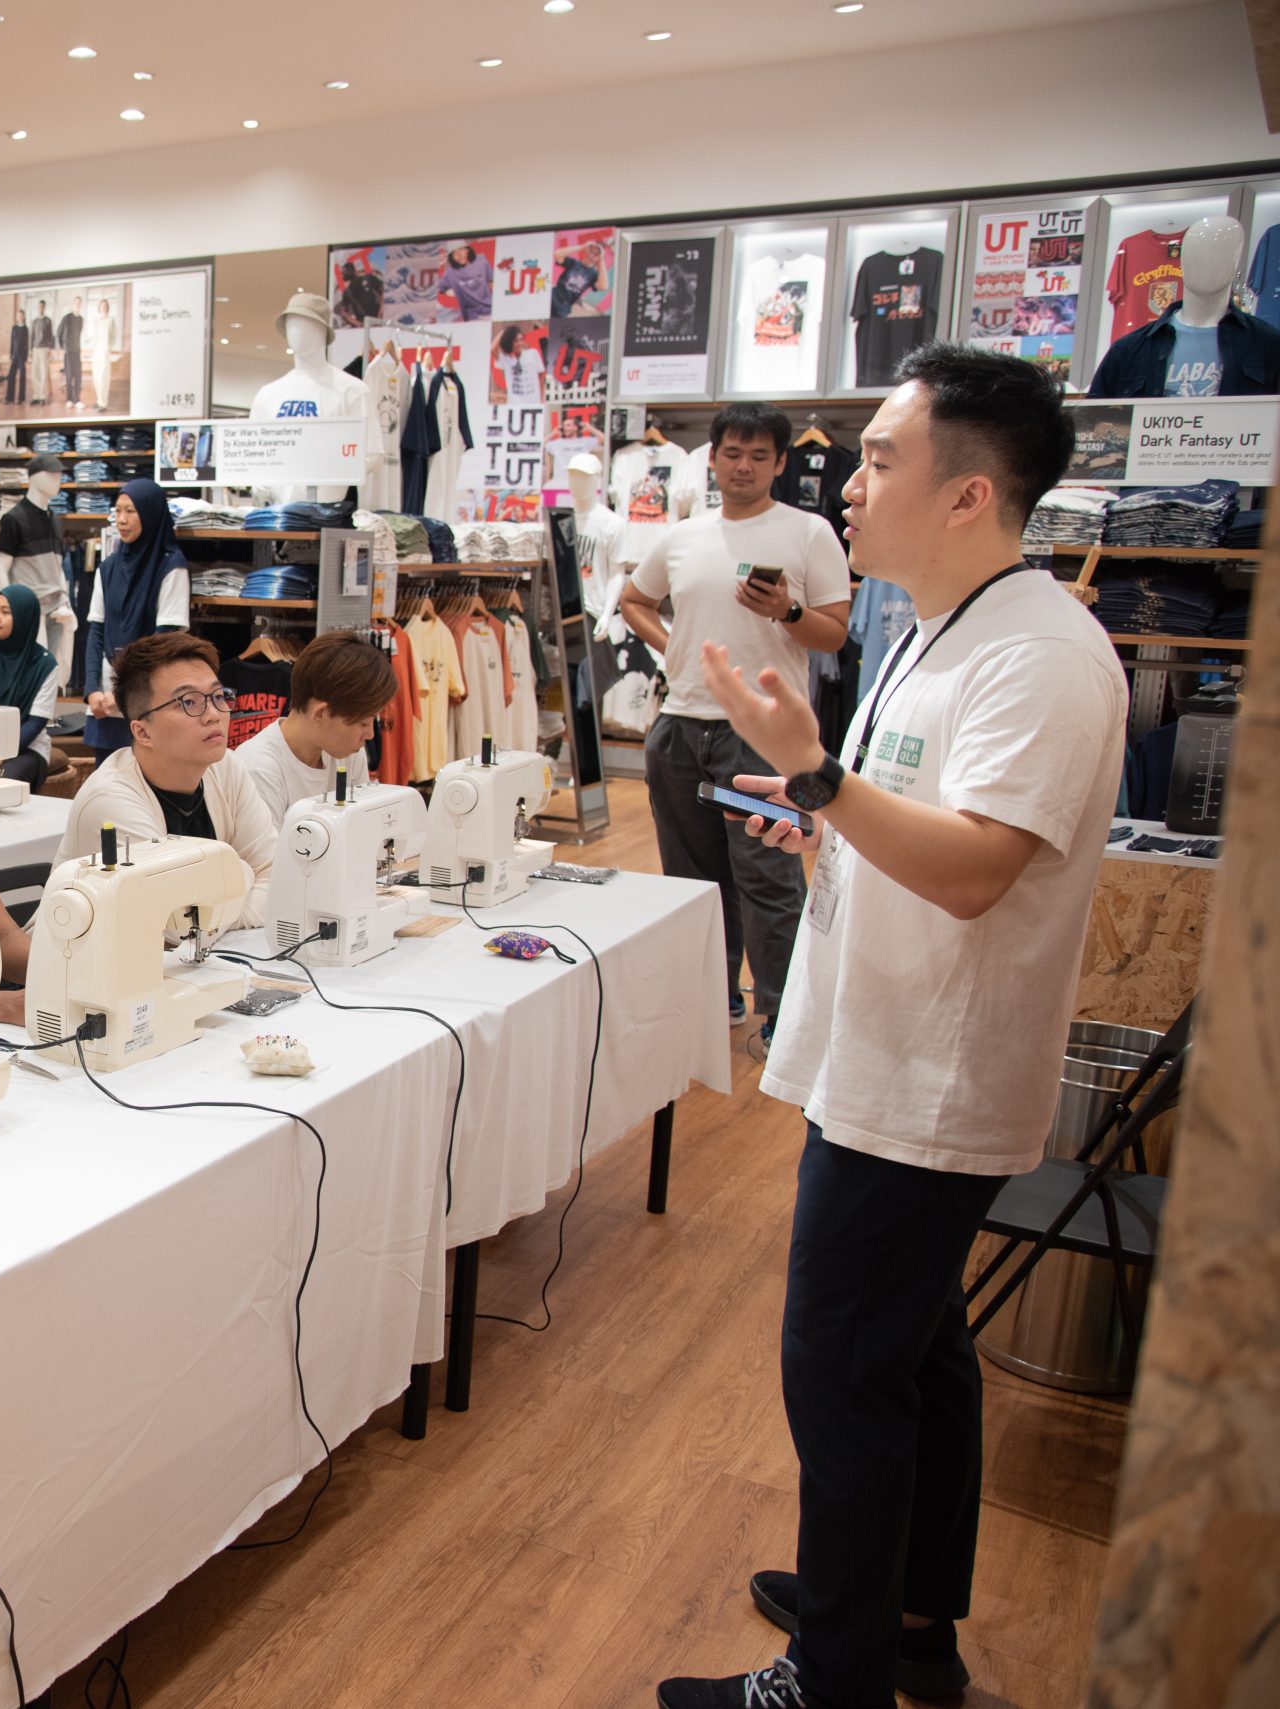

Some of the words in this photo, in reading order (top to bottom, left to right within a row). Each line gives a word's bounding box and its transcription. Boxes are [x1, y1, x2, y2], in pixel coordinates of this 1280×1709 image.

[1038, 213, 1060, 227] UT
[1061, 219, 1082, 233] UT
[985, 221, 1029, 252] UT
[509, 266, 542, 294] UT
[1043, 275, 1066, 292] UT
[553, 345, 604, 387] UT
[627, 369, 641, 380] UT
[276, 400, 319, 418] STAR
[508, 409, 543, 436] UT
[1142, 416, 1204, 429] UKIYO-E
[224, 429, 238, 437] Star
[260, 427, 303, 437] Remastered
[223, 439, 231, 448] by
[233, 438, 257, 448] Kosuke
[258, 438, 296, 447] Kawamura
[1140, 435, 1173, 447] Dark
[1179, 434, 1233, 449] Fantasy
[1239, 433, 1261, 446] UT
[223, 448, 242, 458] Short
[243, 449, 265, 458] Sleeve
[266, 449, 277, 458] UT
[342, 444, 358, 458] UT
[506, 458, 540, 486] UT
[903, 739, 920, 752] UNI
[899, 750, 919, 764] QLO
[881, 769, 905, 784] POWER
[905, 776, 917, 785] OF
